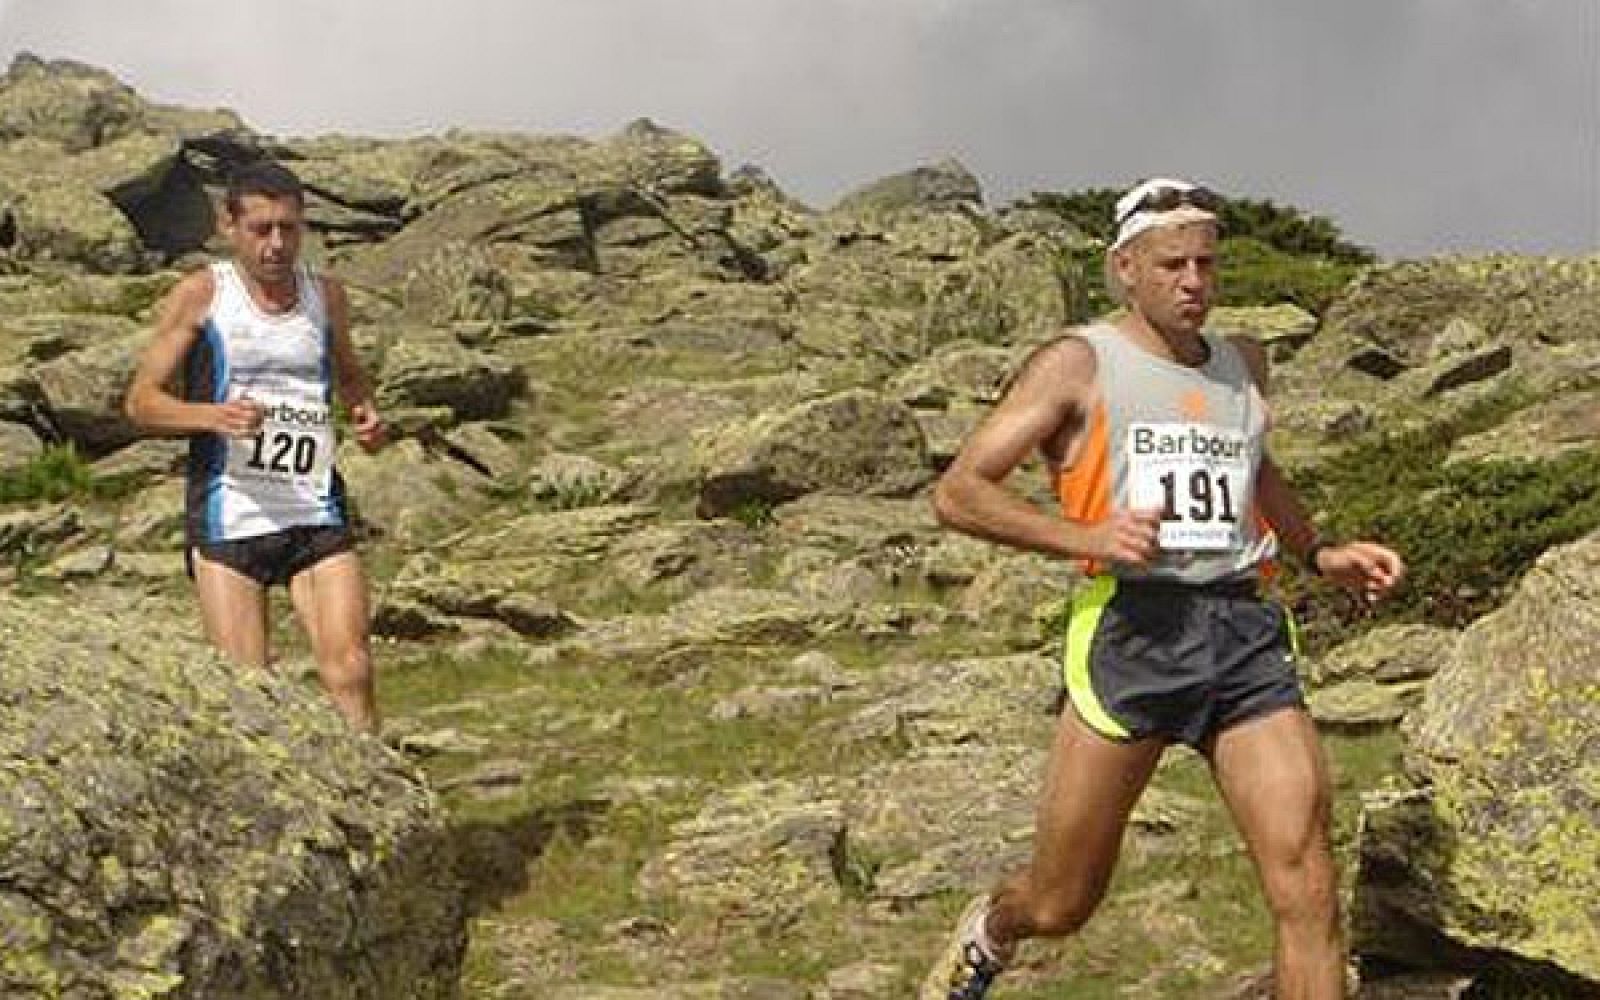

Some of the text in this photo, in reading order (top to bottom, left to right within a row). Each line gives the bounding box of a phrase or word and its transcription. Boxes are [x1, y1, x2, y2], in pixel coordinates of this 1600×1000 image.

[247, 431, 315, 474] 120
[1134, 427, 1244, 457] Barbour
[1159, 469, 1237, 523] 191
